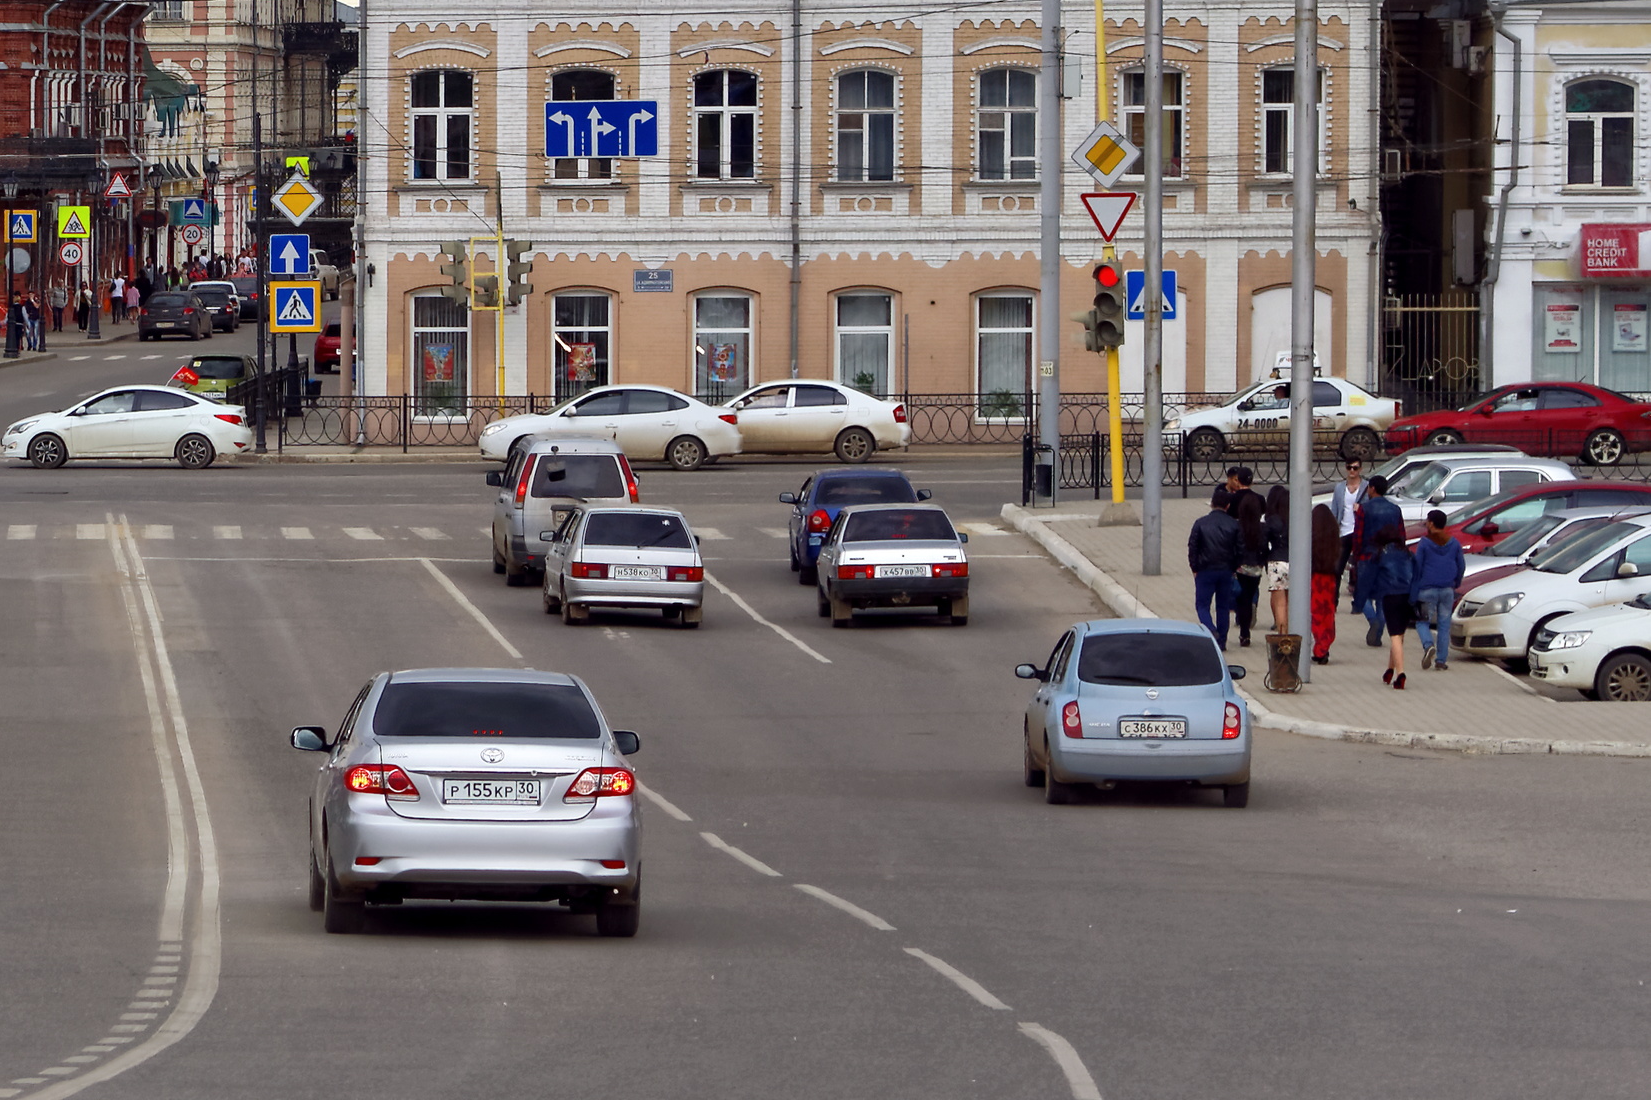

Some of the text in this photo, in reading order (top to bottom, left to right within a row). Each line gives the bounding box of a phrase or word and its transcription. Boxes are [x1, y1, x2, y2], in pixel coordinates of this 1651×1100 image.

[186, 230, 198, 239] 20
[1587, 239, 1619, 248] HOME
[64, 249, 79, 259] 40
[1587, 248, 1627, 257] CREDIT
[1587, 258, 1618, 267] BANK
[1237, 417, 1278, 429] 24-0000
[518, 782, 534, 794] 30
